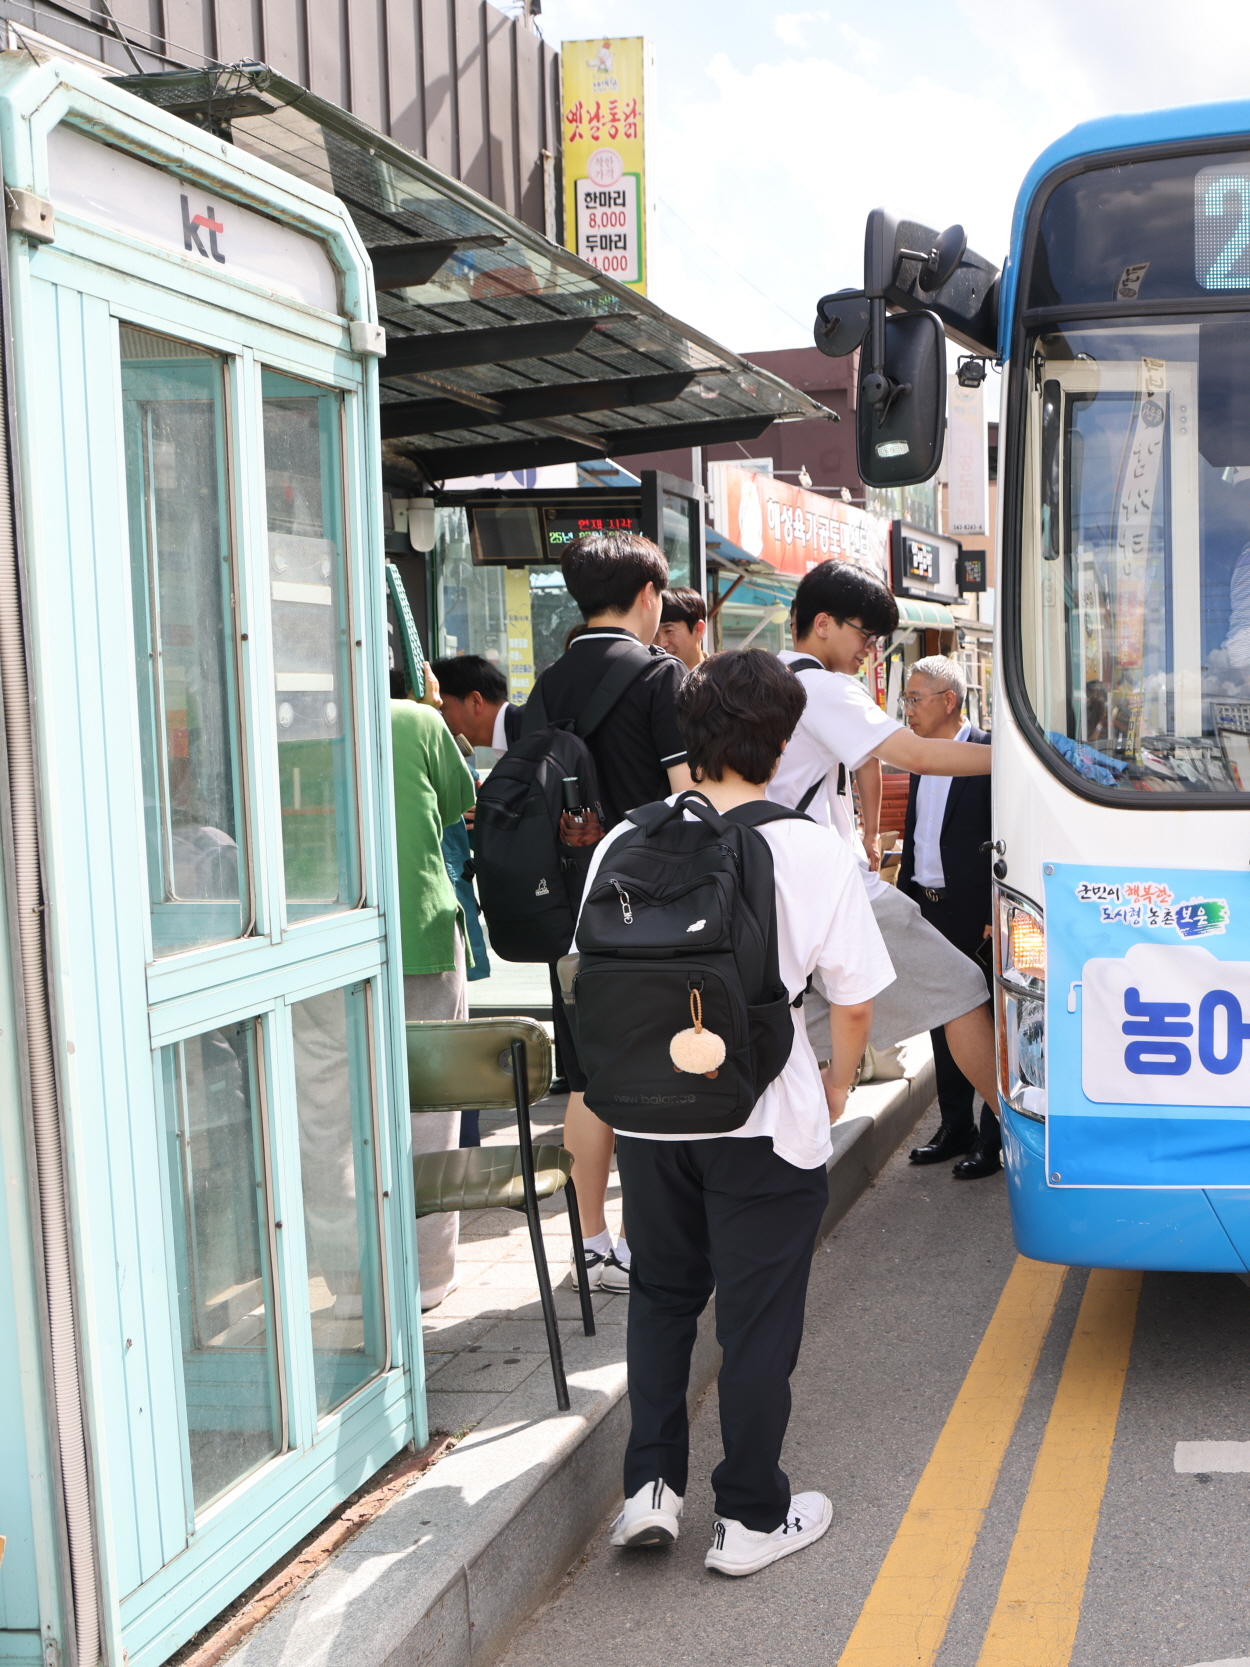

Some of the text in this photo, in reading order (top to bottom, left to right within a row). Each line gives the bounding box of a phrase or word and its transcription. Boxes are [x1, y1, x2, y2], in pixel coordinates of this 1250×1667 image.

[584, 190, 626, 209] 한마리
[180, 194, 225, 264] kt
[589, 211, 626, 230] 8,000
[586, 233, 627, 252] 두마리
[578, 517, 633, 530] 현재 시각
[1077, 883, 1172, 904] 군민이 행복한
[1102, 906, 1208, 925] 도시형 농촌 보은
[613, 1094, 638, 1104] new
